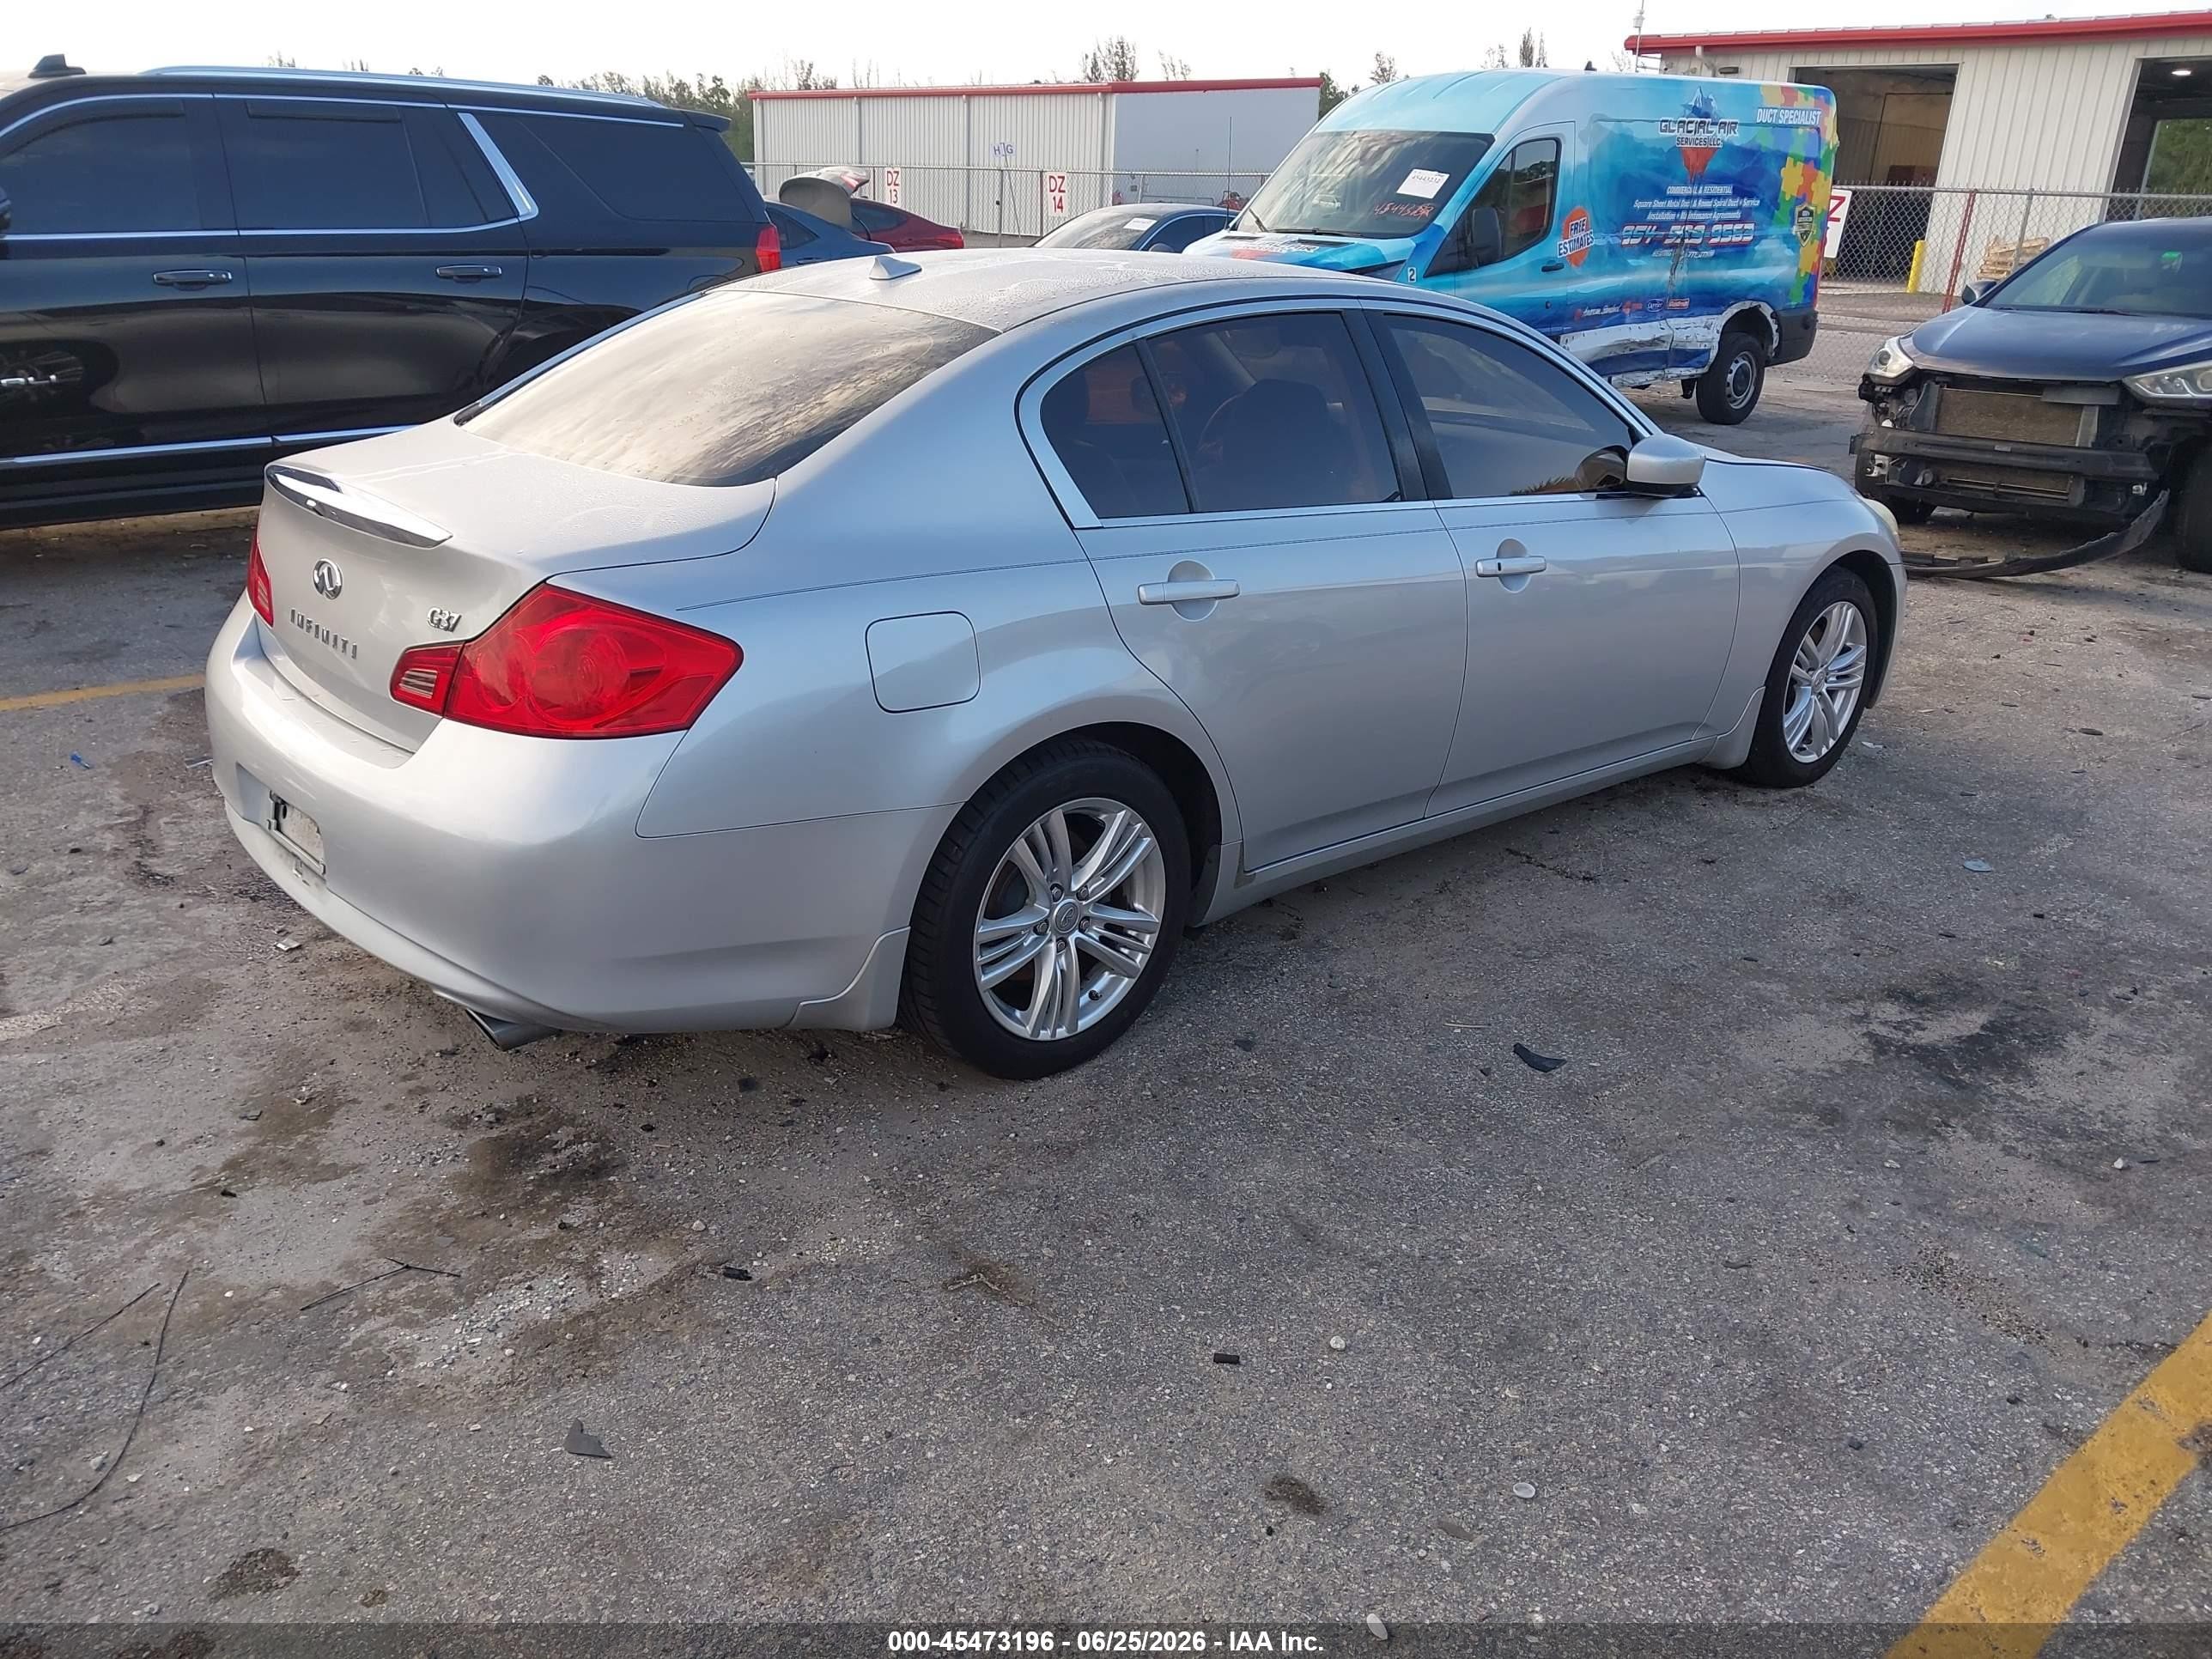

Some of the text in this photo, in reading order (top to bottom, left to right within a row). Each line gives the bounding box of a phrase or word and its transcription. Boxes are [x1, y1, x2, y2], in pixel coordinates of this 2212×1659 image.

[1757, 108, 1821, 125] DUCT SPECIALIST
[1659, 118, 1739, 137] GLACIAL AIR
[1676, 137, 1707, 146] SERVICES
[886, 171, 900, 187] DZ
[1048, 175, 1066, 193] DZ
[889, 189, 898, 204] 13
[1704, 185, 1733, 194] RESIDENTIAL
[1052, 196, 1064, 214] 14
[1633, 199, 1652, 210] Square
[1653, 199, 1666, 208] Sheet
[1713, 198, 1727, 209] Spiral
[1742, 198, 1760, 207] Service
[1558, 230, 1595, 257] ESTIMATES
[1408, 268, 1416, 282] 2
[427, 606, 463, 634] G37
[289, 607, 358, 660] INFINITI
